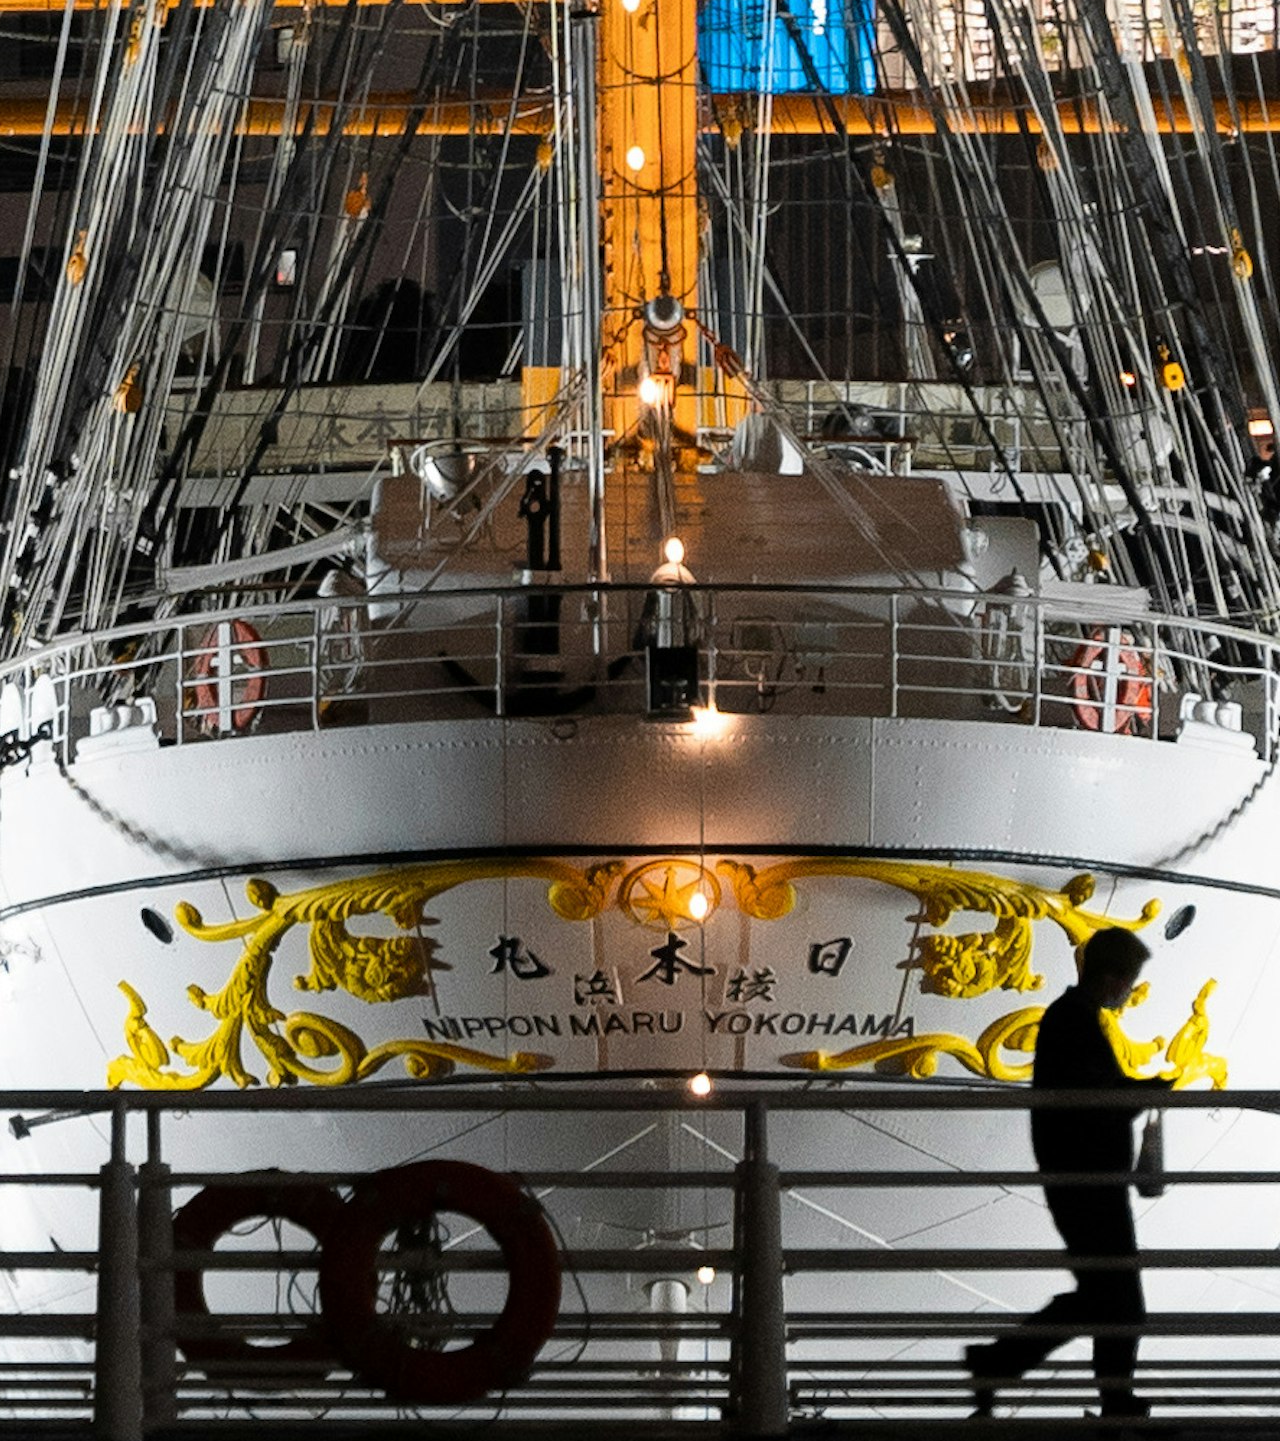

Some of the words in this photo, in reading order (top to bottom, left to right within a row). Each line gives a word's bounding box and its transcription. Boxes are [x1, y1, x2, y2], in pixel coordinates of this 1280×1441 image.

[424, 1015, 561, 1041] NIPPON
[570, 1011, 682, 1037] MARU
[706, 1012, 917, 1038] YOKOHAMA
